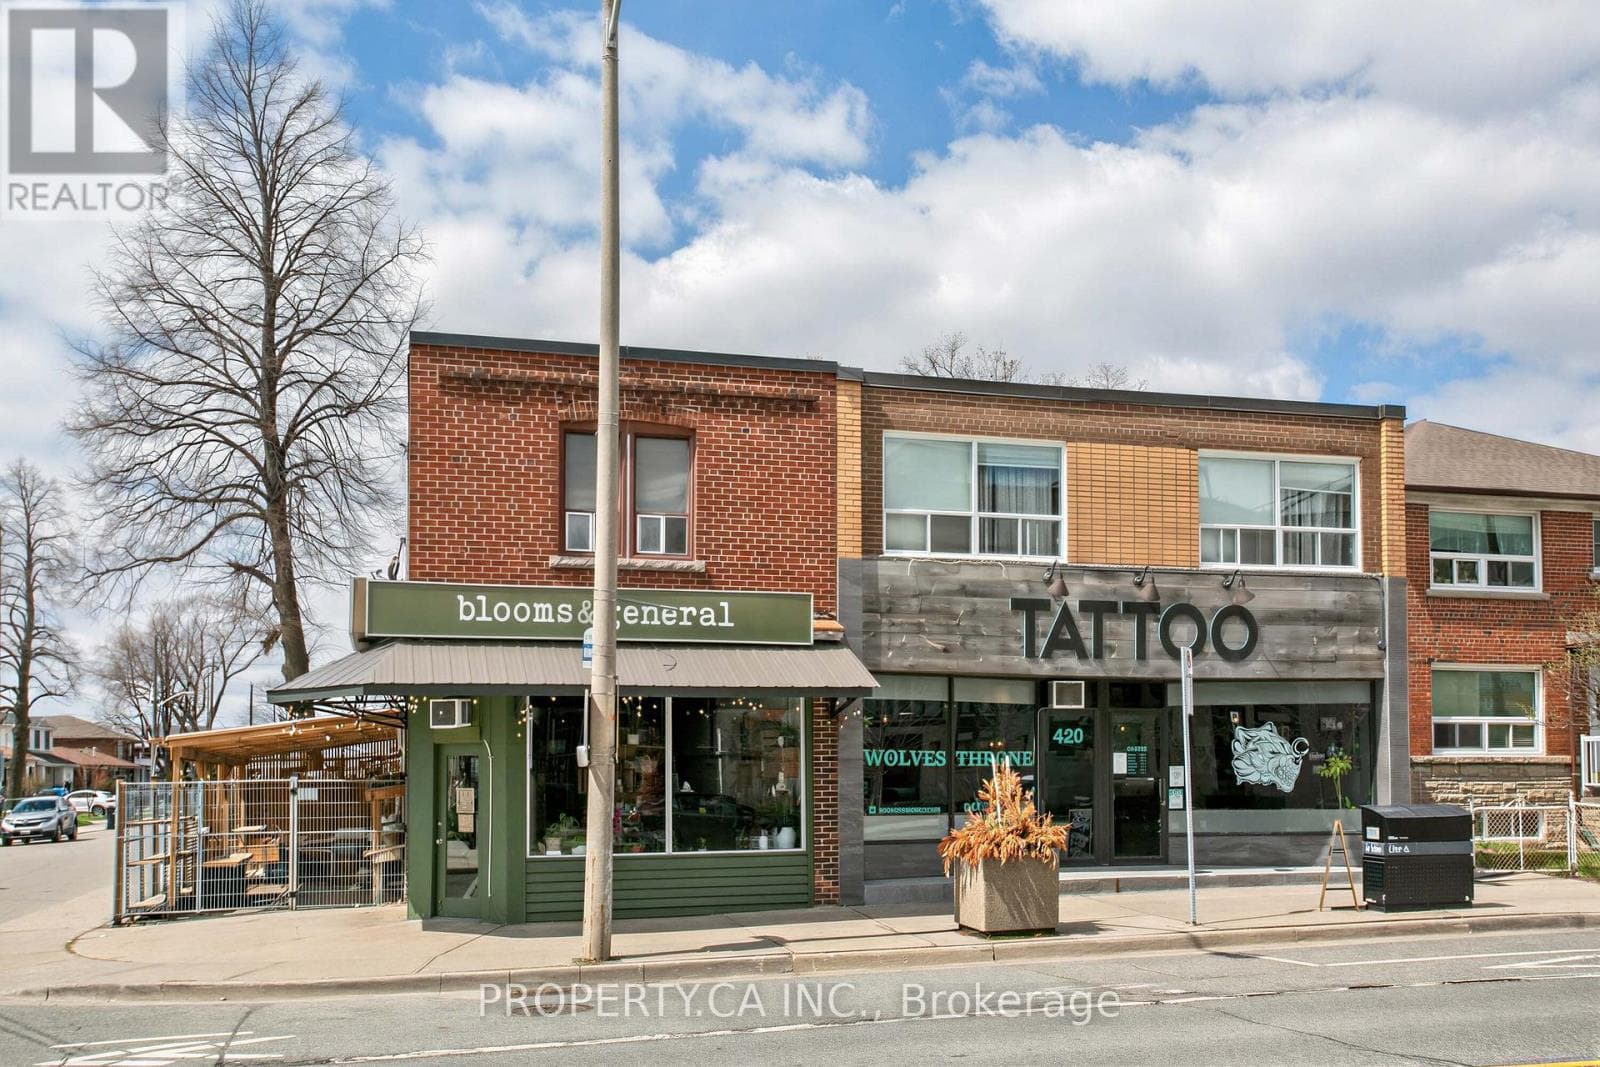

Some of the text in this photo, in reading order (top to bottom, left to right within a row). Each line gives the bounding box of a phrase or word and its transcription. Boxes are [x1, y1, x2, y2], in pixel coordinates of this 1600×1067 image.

[1009, 597, 1258, 662] TATTOO
[1053, 727, 1084, 745] 420
[864, 749, 947, 767] WOLVES
